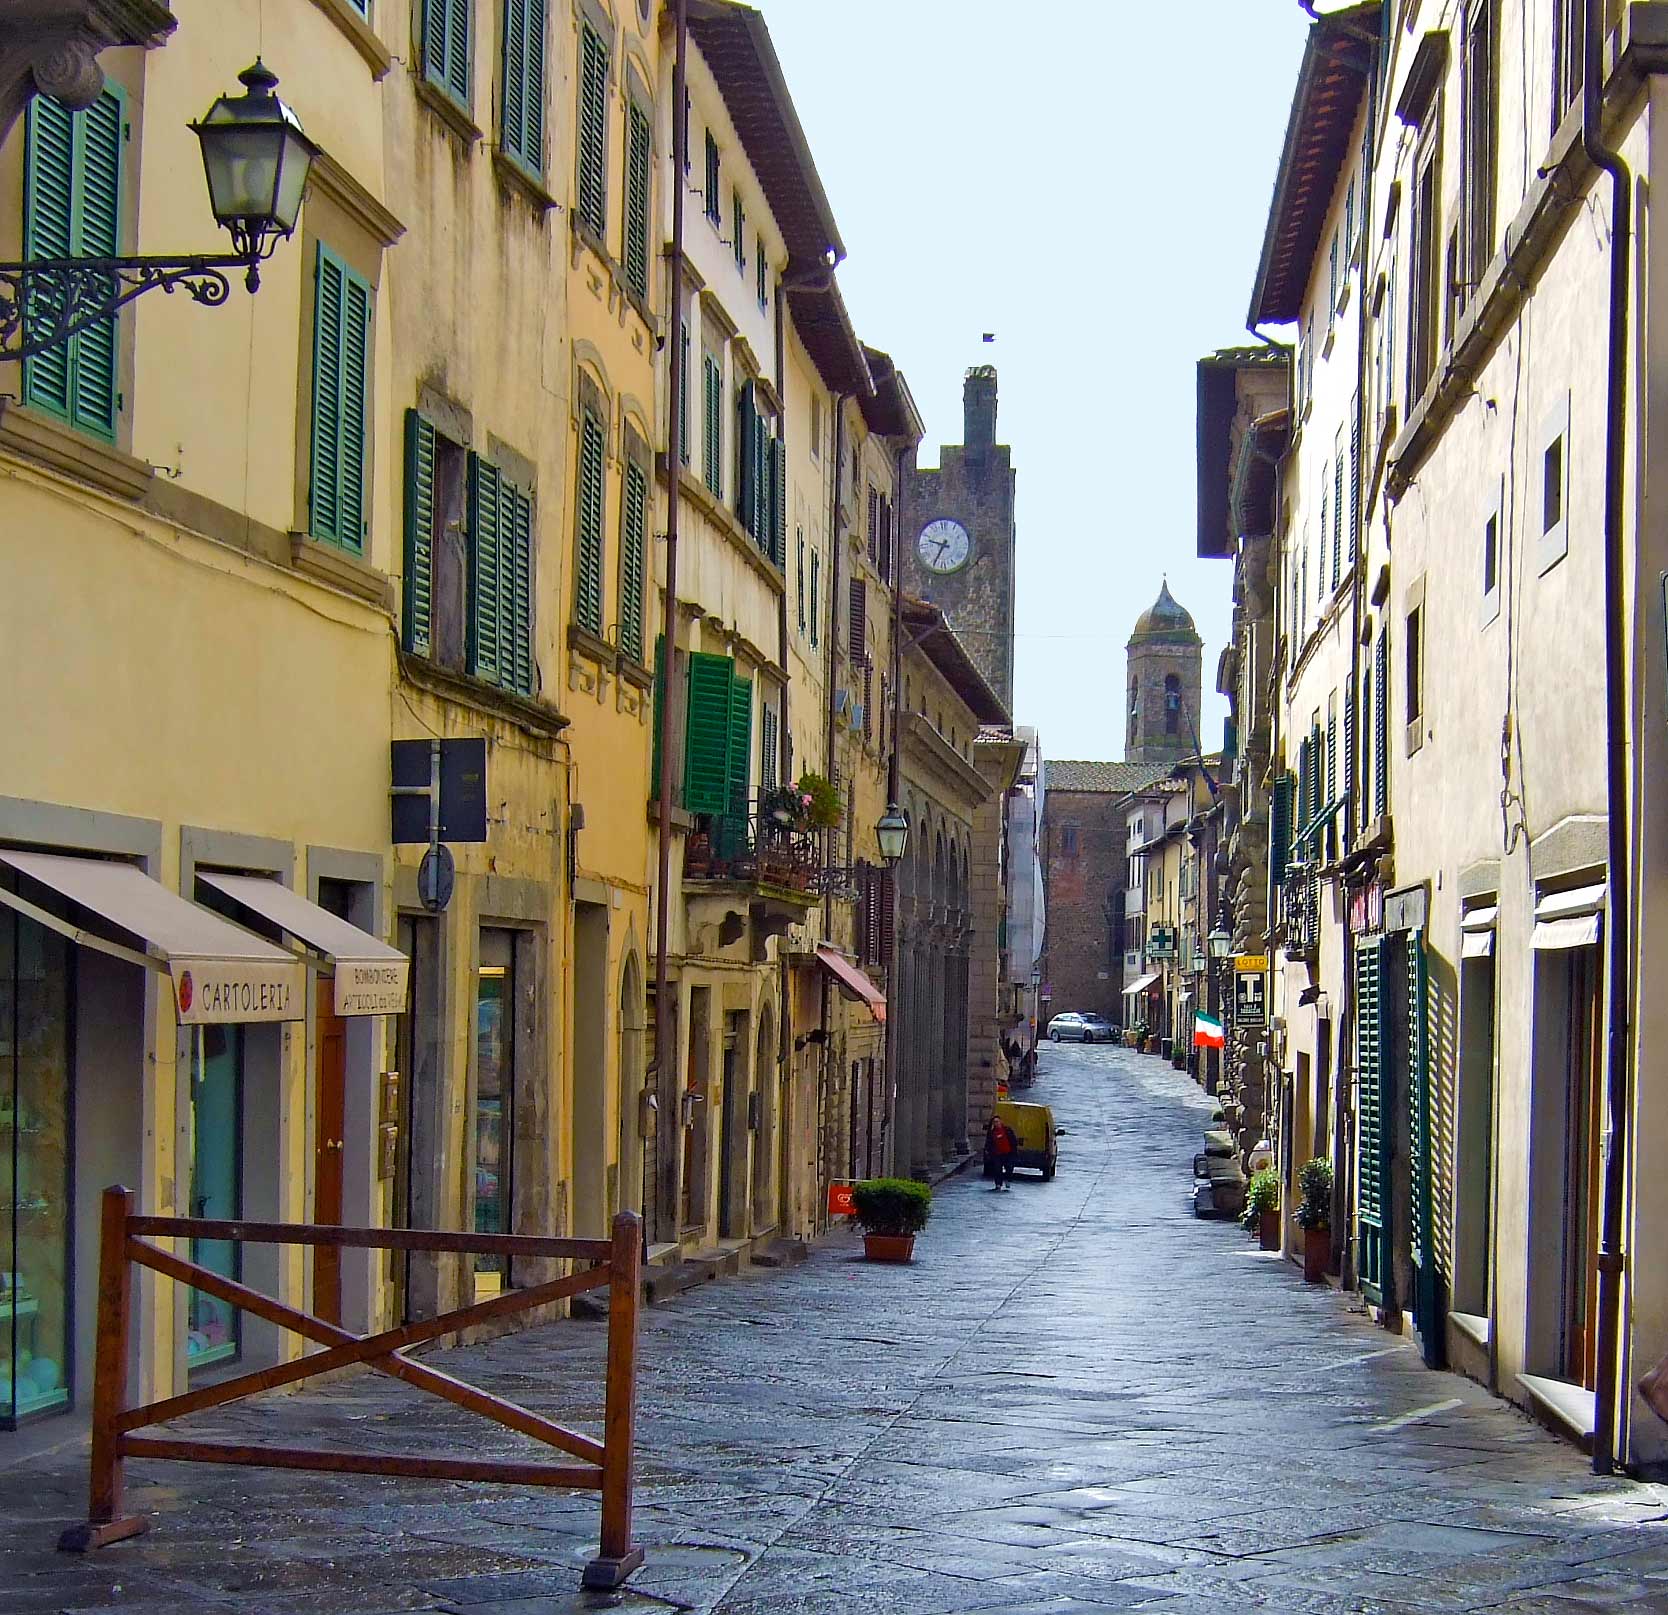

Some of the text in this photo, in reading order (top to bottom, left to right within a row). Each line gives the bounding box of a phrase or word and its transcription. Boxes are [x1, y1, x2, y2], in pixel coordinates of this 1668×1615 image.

[1238, 958, 1265, 966] LOTTO
[202, 982, 290, 1011] CARTOLERIA
[1240, 974, 1260, 1002] T
